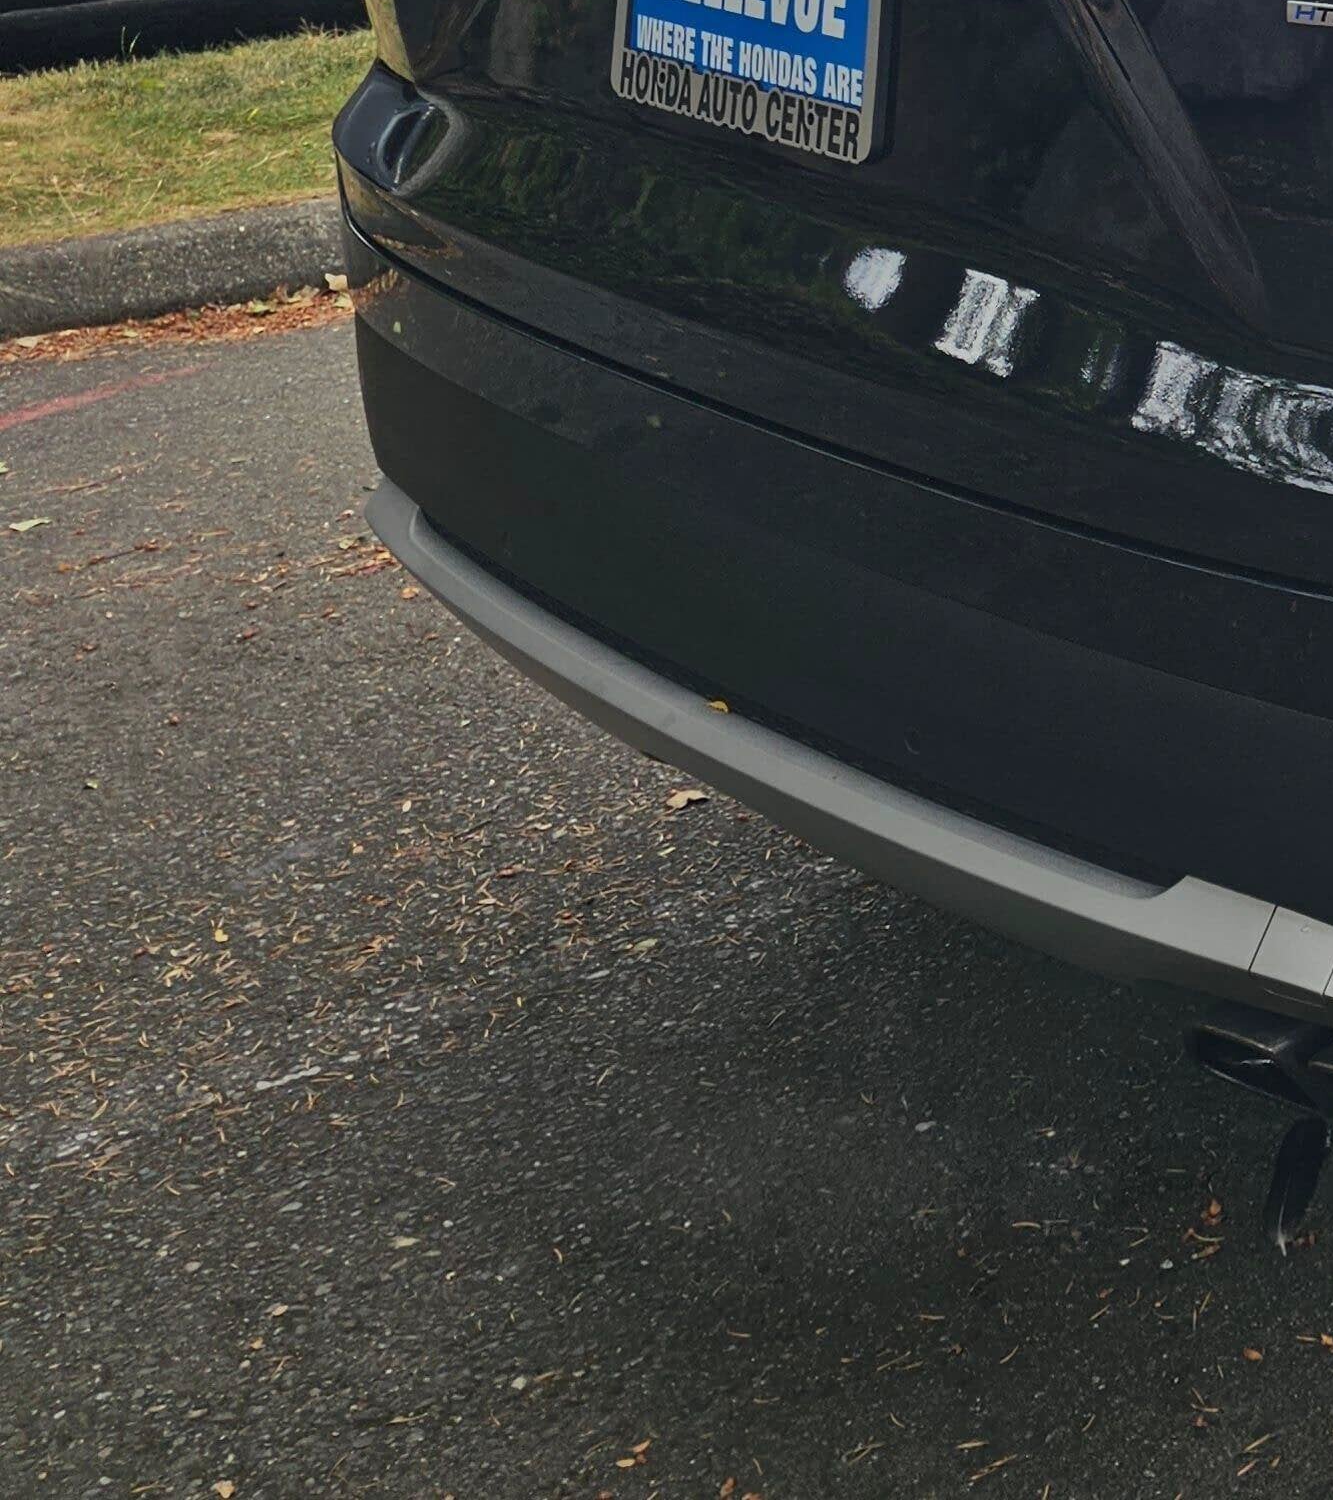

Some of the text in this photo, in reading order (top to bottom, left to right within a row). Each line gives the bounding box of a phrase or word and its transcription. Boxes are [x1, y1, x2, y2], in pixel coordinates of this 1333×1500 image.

[619, 50, 861, 161] HONDA AUTO CENTER
[636, 14, 863, 108] WHERE THE HONDAS ARE
